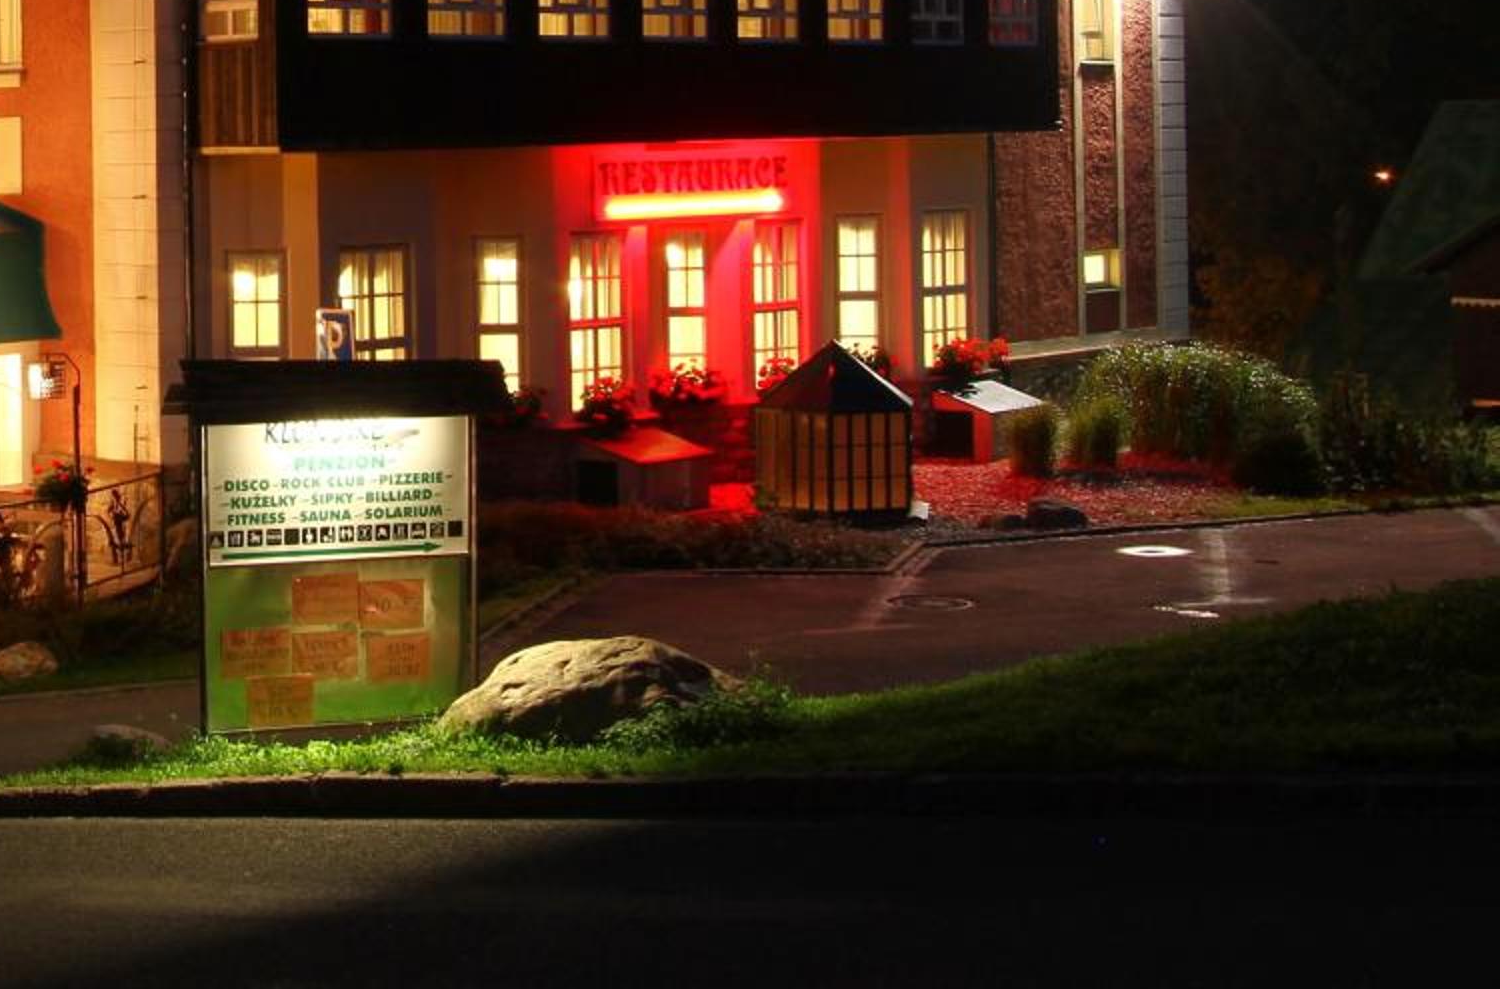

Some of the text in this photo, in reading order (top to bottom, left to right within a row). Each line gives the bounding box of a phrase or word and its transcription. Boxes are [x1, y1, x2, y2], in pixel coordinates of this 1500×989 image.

[599, 156, 788, 195] RESTAURACE
[224, 471, 444, 492] DISCO ROCK CLUB PIZZERIE
[365, 489, 433, 503] BILLIARD
[227, 505, 443, 526] FITNESS SAUNA SOLARIUM
